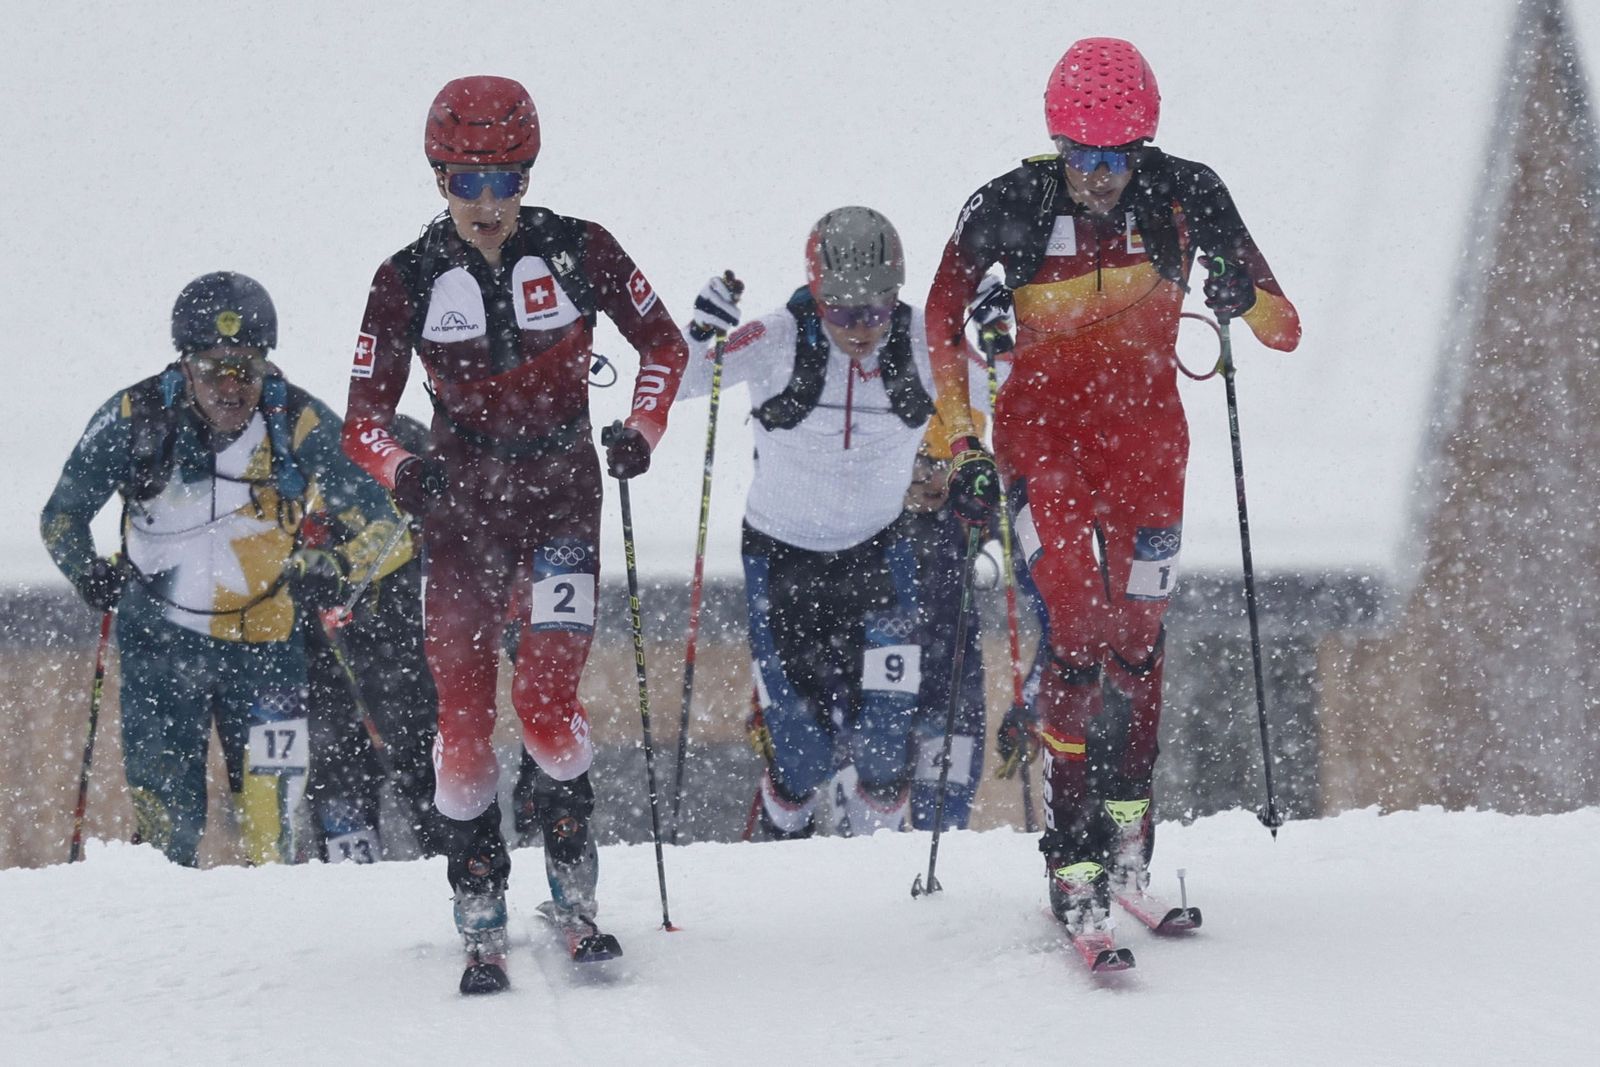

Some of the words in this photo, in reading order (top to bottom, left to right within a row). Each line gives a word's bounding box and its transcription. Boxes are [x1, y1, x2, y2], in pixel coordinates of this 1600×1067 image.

[633, 363, 672, 411] SUI
[360, 427, 399, 457] SUI
[1159, 565, 1171, 590] 1
[553, 582, 576, 613] 2
[885, 653, 904, 684] 9
[264, 730, 296, 759] 17
